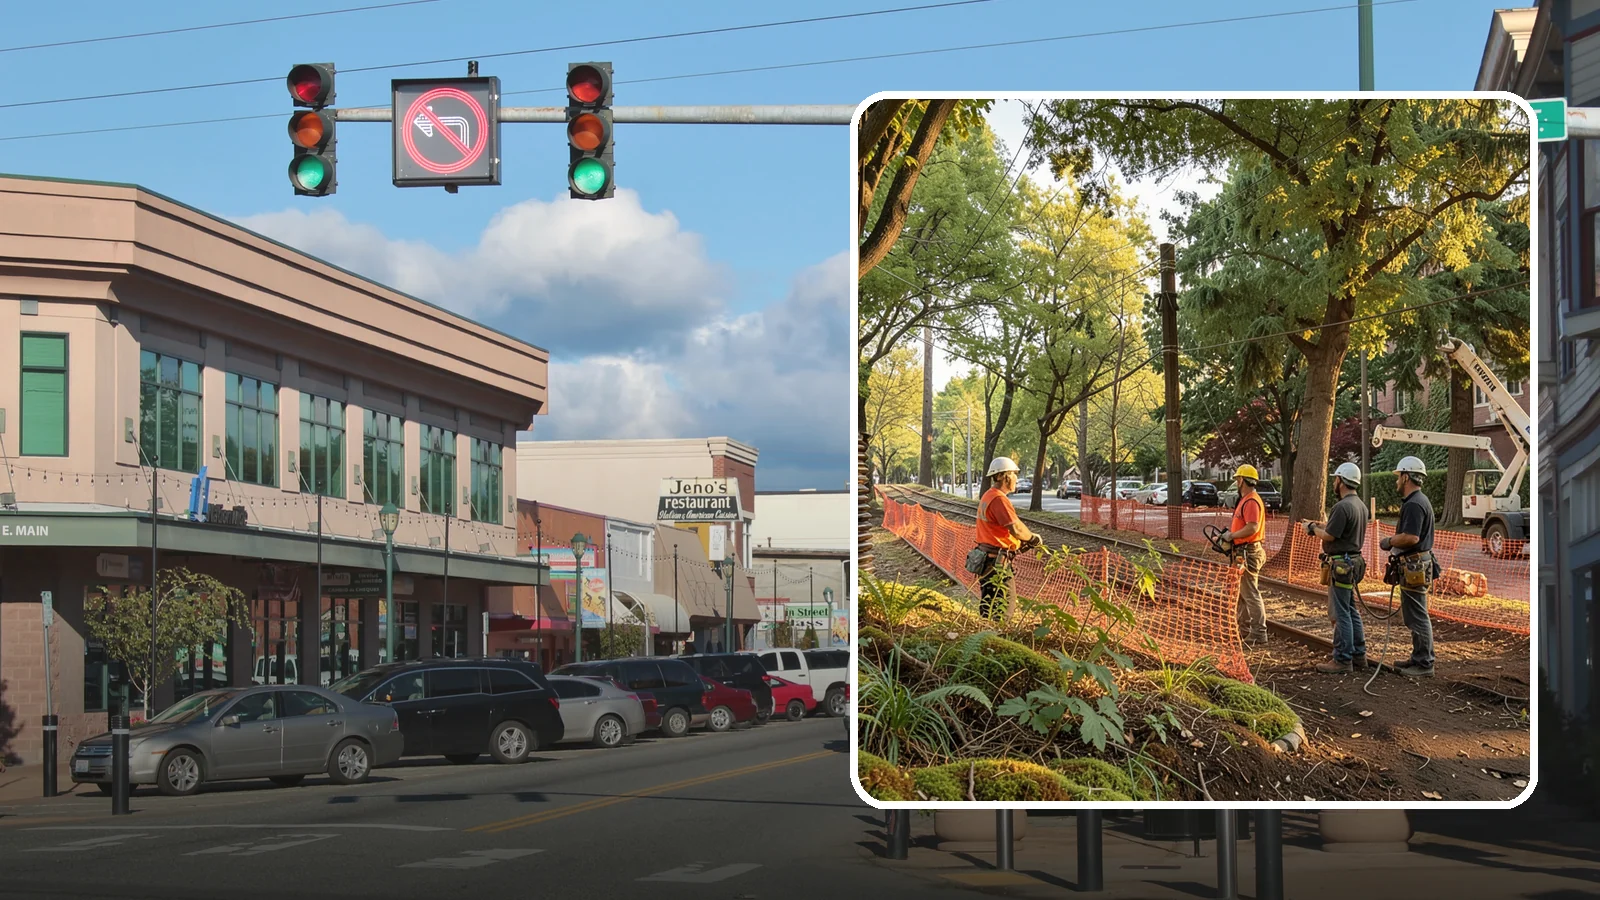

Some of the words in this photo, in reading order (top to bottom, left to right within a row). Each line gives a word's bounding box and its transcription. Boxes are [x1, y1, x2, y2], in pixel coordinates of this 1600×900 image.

[669, 480, 727, 494] Jeno's
[665, 496, 731, 509] restaurant
[686, 509, 715, 519] American
[715, 509, 737, 519] Cuisine
[2, 525, 13, 536] E.
[15, 525, 49, 536] MAIN
[797, 607, 828, 617] Street
